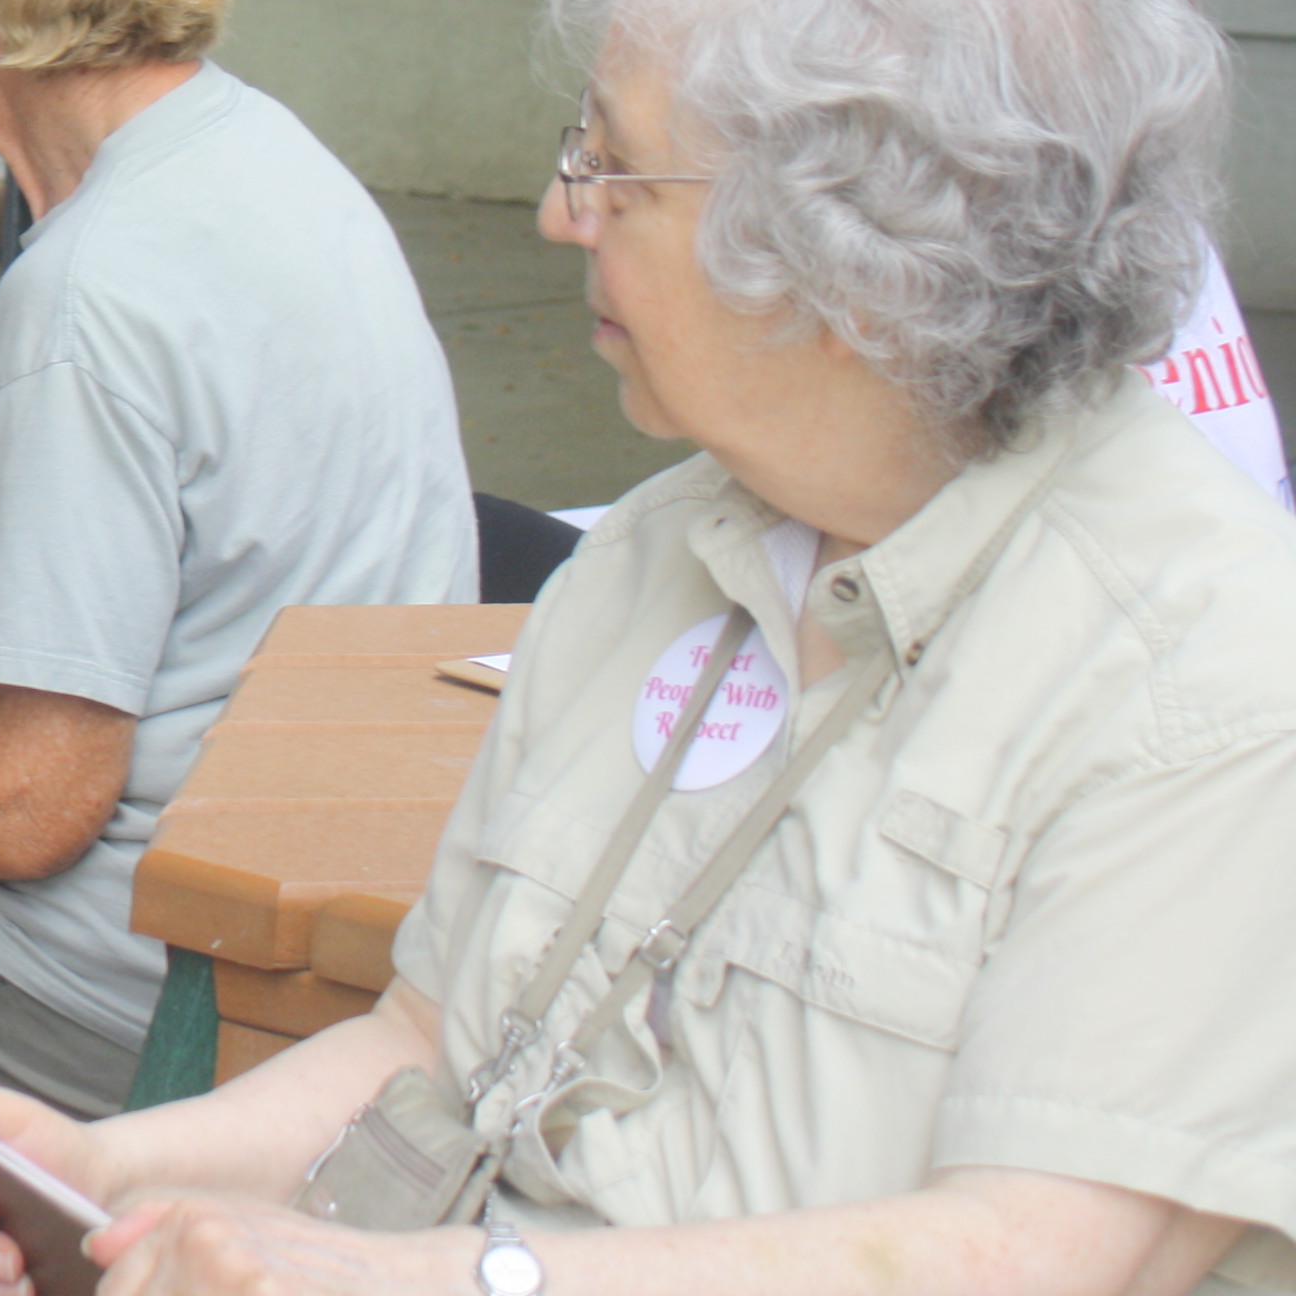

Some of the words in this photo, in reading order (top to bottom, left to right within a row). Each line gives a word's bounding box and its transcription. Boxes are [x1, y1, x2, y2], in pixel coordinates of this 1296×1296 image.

[645, 676, 696, 710] Peop
[721, 681, 779, 712] With
[655, 710, 742, 741] Rpect
